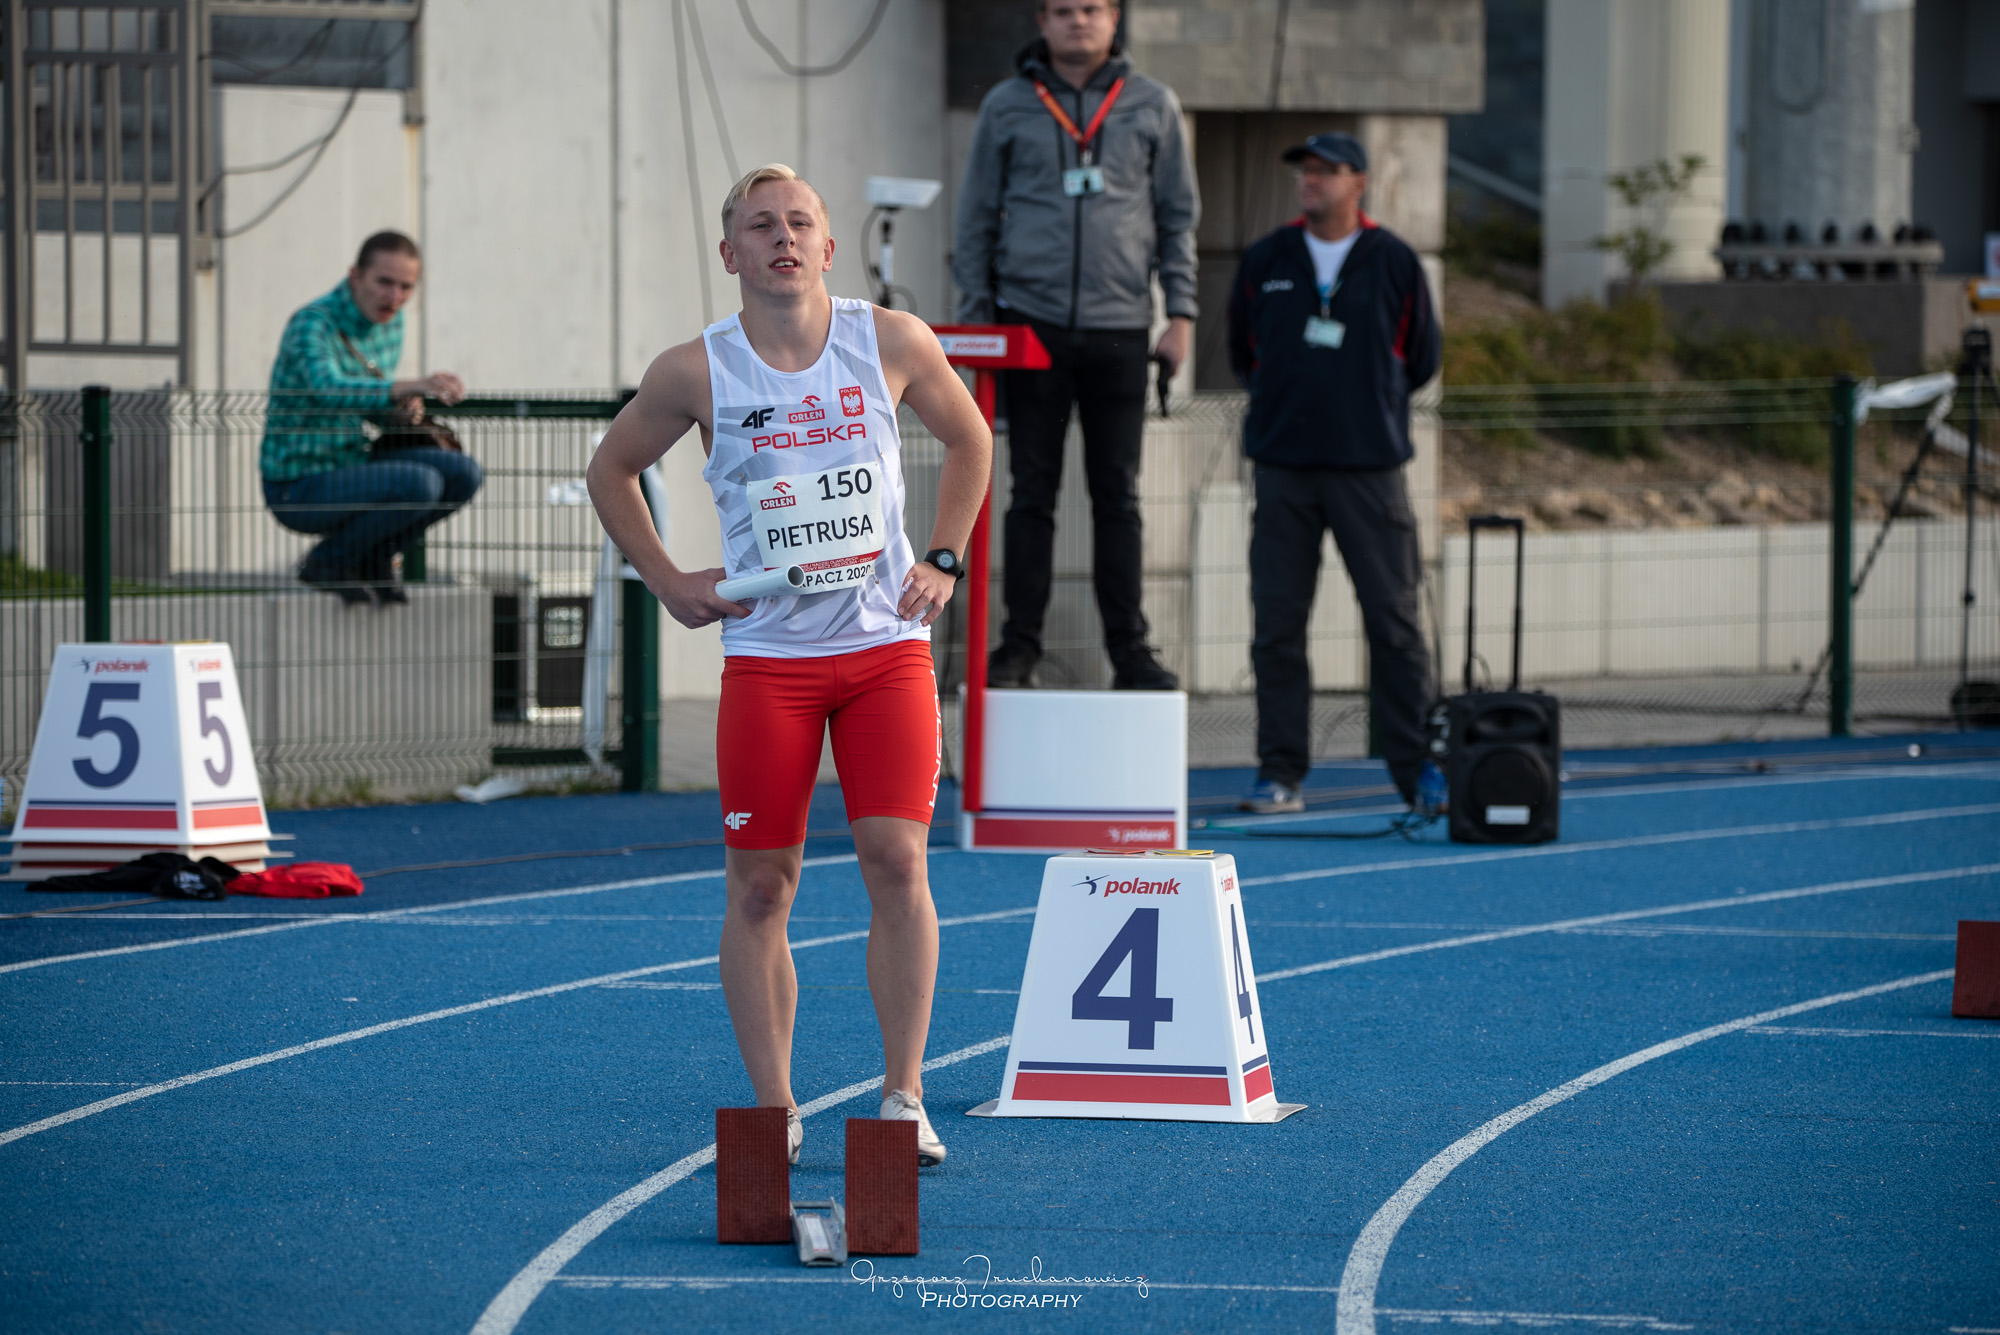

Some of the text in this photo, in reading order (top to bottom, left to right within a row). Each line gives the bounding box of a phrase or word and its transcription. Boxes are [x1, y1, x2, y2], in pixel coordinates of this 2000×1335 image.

[741, 407, 775, 429] 4F
[790, 411, 824, 422] ORLEN
[752, 423, 867, 453] POLSKA
[817, 468, 872, 501] 150
[762, 497, 795, 510] ORLEN
[767, 514, 874, 550] PIETRUSA
[800, 570, 843, 588] PACZ
[72, 681, 141, 790] 5
[198, 681, 233, 788] 5
[724, 811, 752, 831] 4F
[1103, 877, 1181, 898] polanik
[1071, 907, 1174, 1050] 4
[1230, 903, 1255, 1045] 4
